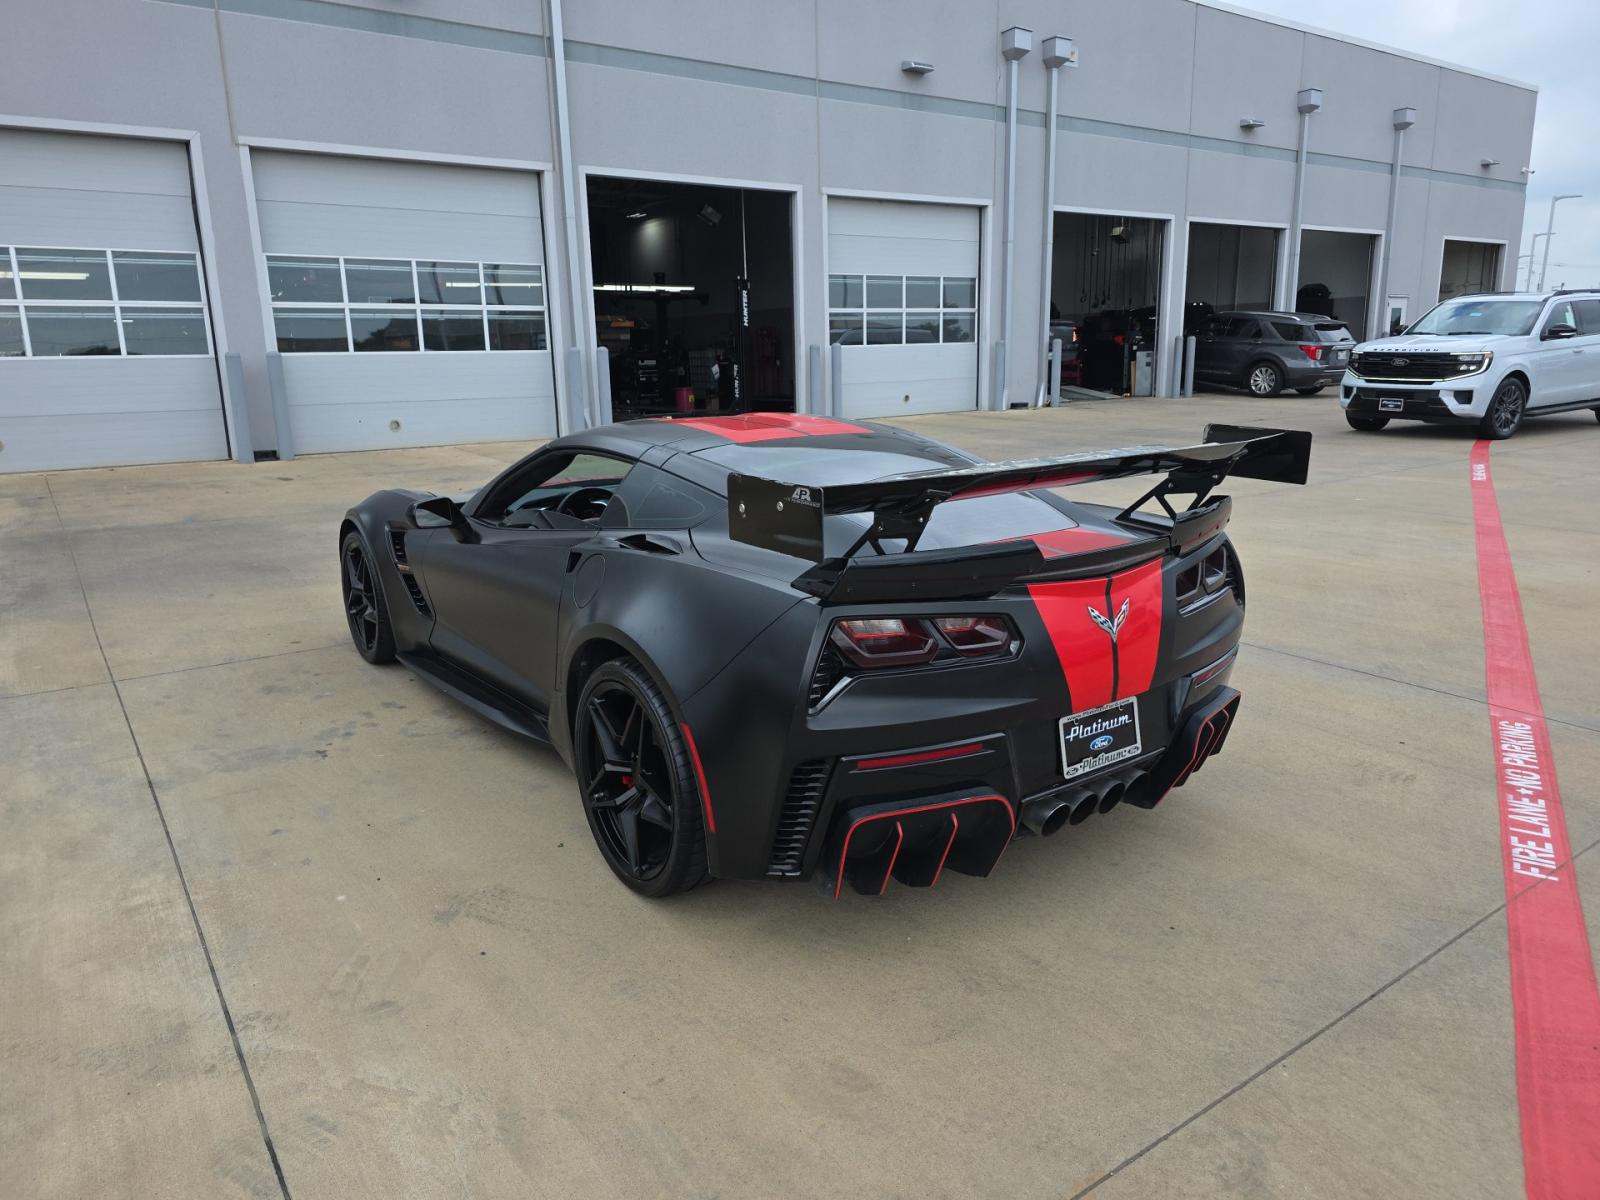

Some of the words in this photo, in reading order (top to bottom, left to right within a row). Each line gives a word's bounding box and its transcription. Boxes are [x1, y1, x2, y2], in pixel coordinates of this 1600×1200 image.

[1064, 714, 1133, 742] Platinum
[1092, 737, 1110, 749] Ford
[1499, 720, 1539, 769] PARKING
[1505, 768, 1543, 791] NO
[1506, 793, 1551, 838] LANE
[1510, 835, 1559, 881] FIRE
